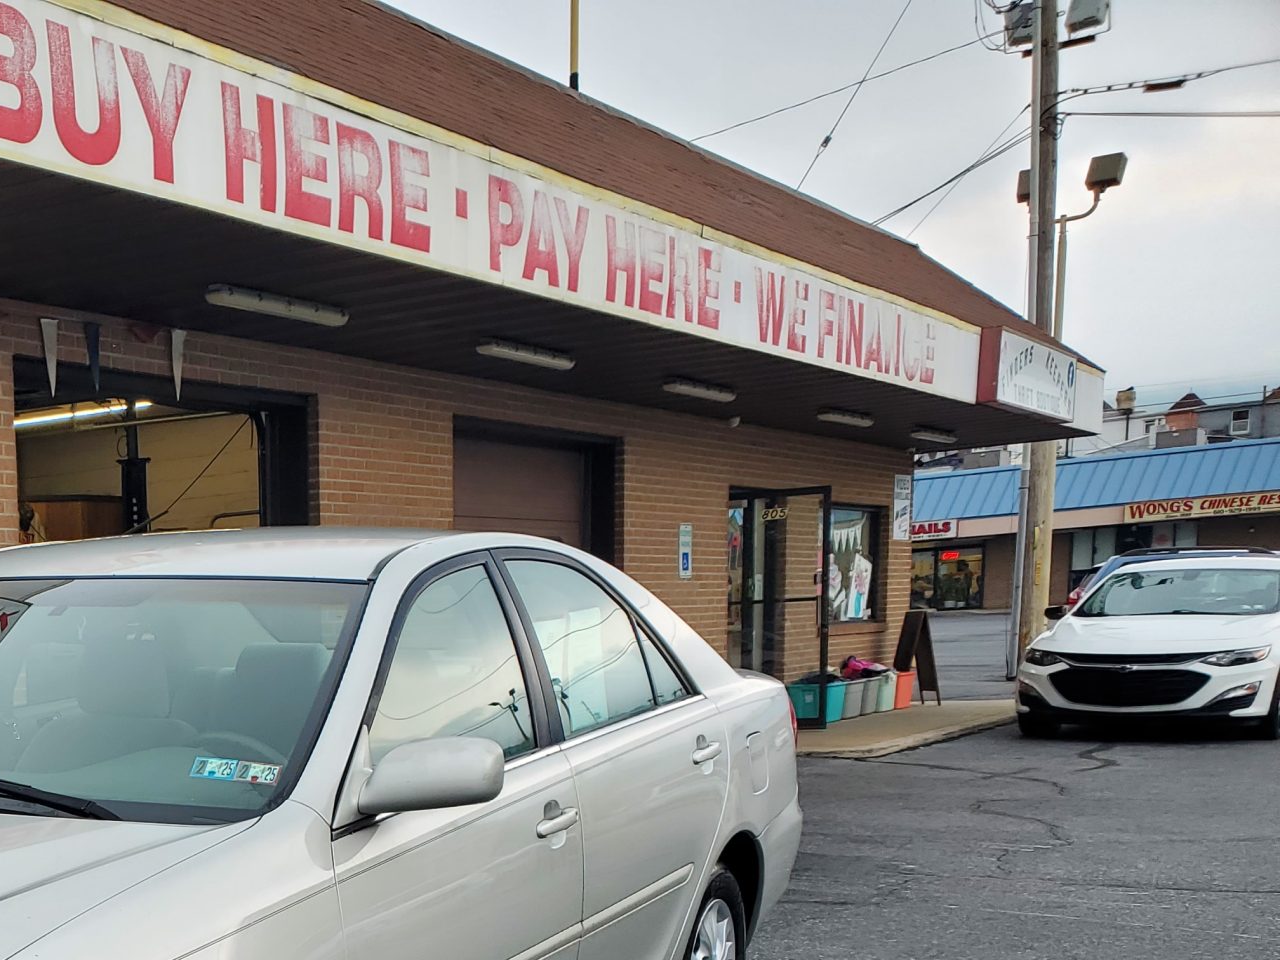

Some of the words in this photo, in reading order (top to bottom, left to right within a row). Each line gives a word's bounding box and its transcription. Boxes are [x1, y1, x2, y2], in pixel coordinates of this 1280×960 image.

[221, 80, 431, 253] HERE
[489, 173, 589, 293] PAY
[606, 214, 722, 330] HERE
[755, 266, 809, 353] WE
[818, 288, 936, 385] FINANCE
[1001, 344, 1034, 396] FINDERS
[762, 508, 787, 520] 805
[1129, 499, 1194, 519] WONG'S
[1200, 495, 1255, 510] CHINESE
[221, 761, 234, 776] 25
[238, 763, 251, 779] 2
[264, 766, 277, 781] 25
